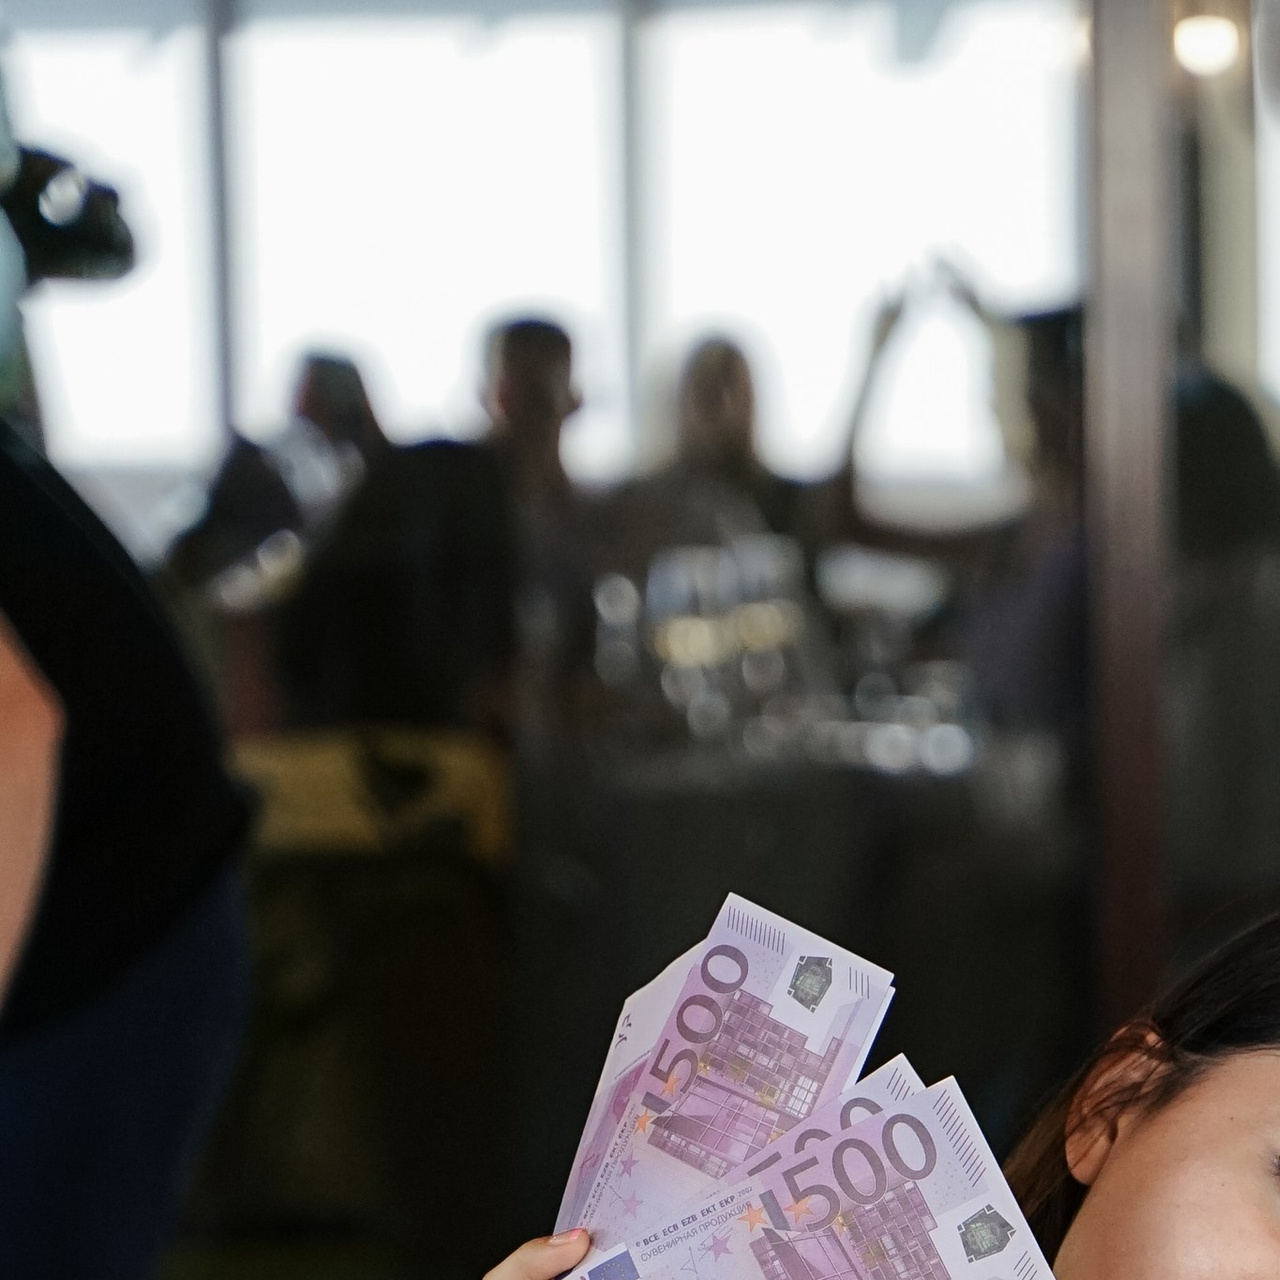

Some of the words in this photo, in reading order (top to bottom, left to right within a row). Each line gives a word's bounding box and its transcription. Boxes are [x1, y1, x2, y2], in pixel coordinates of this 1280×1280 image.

[649, 944, 749, 1094] 500
[782, 1113, 937, 1232] 500
[640, 1228, 699, 1262] СУВЕНИРНАЯ
[698, 1200, 753, 1232] ПРОДУКЦИЯ
[642, 1232, 660, 1247] BCE
[662, 1224, 679, 1237] ECB
[681, 1214, 698, 1227] EZB
[700, 1204, 718, 1217] EKT
[719, 1194, 736, 1208] EKP
